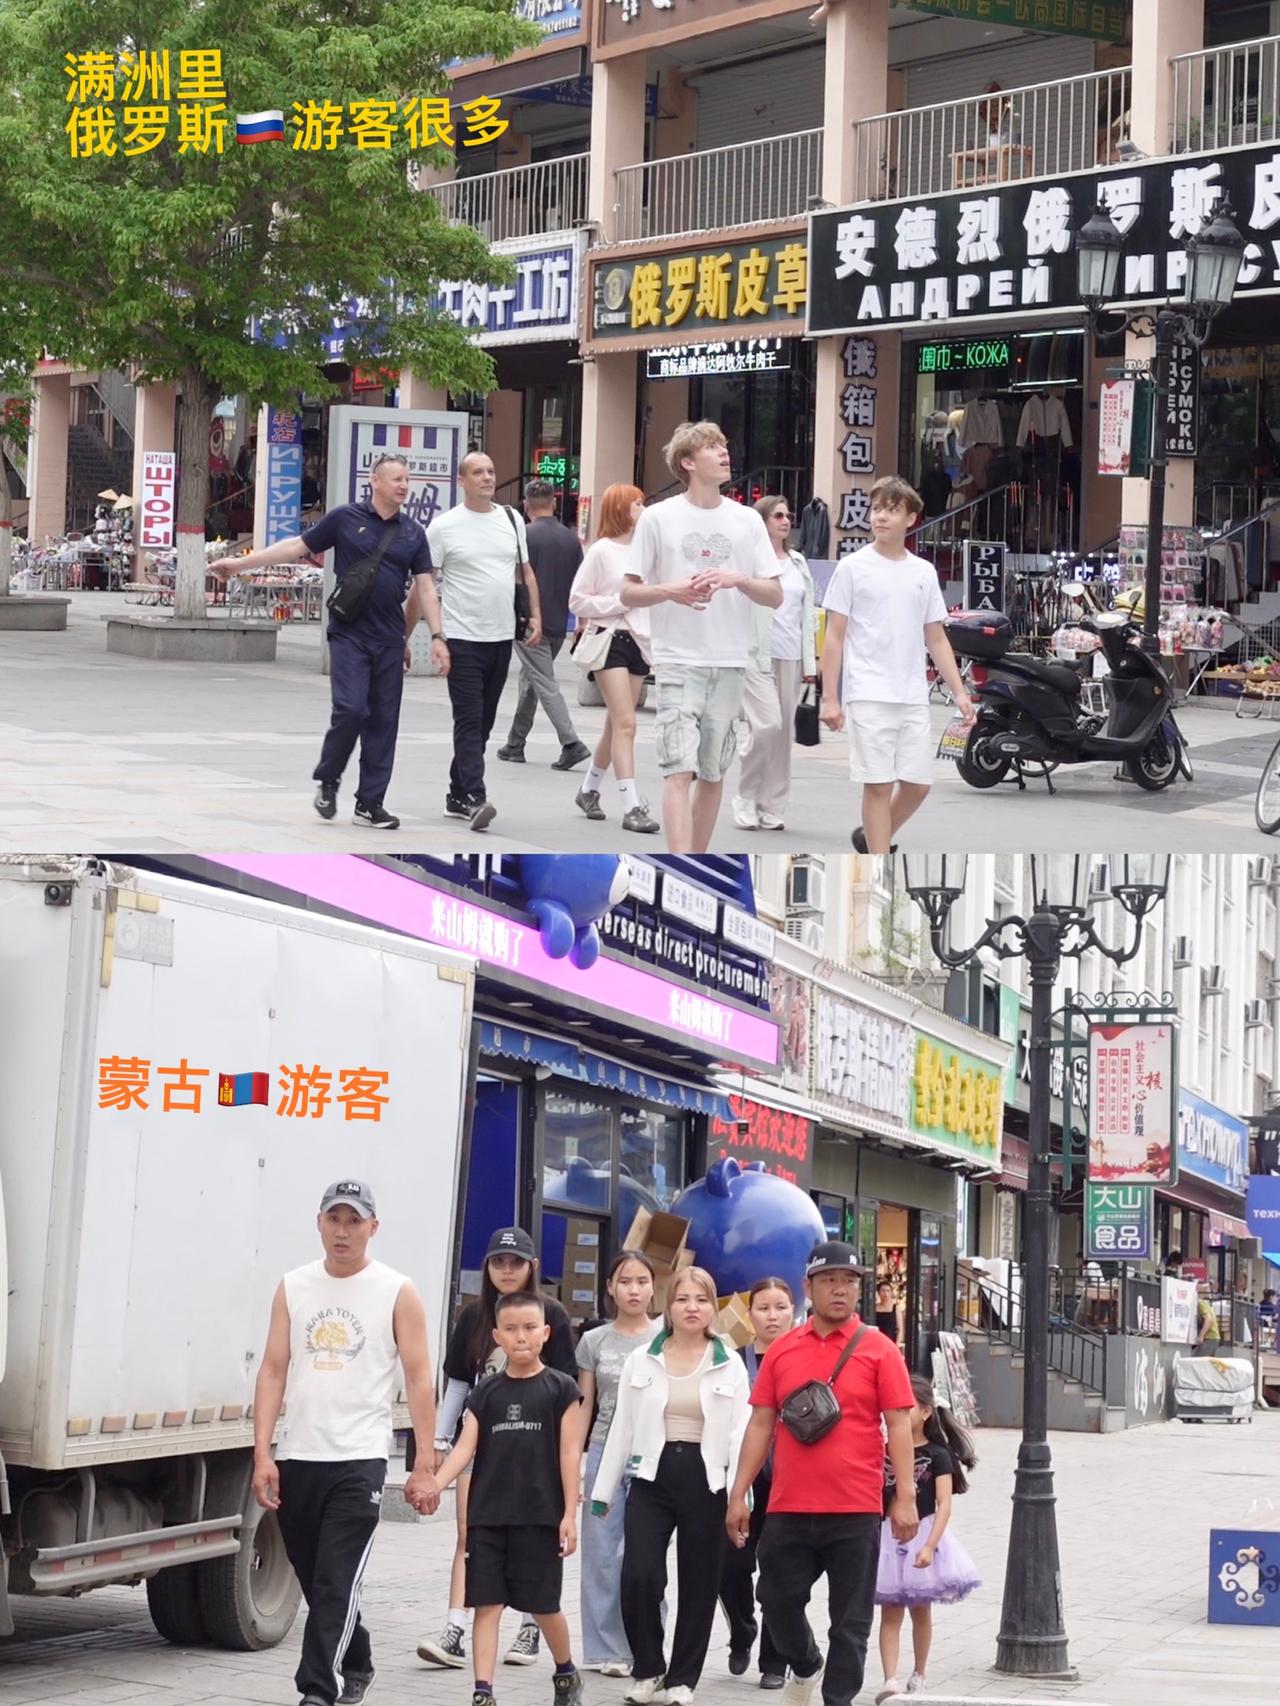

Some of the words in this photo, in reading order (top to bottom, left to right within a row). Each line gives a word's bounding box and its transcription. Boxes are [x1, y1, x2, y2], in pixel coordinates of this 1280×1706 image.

[629, 243, 807, 328] 俄罗斯皮草
[857, 258, 1049, 321] АНДРЕЙ
[965, 340, 1009, 367] КОЖА
[1178, 365, 1194, 437] СУМОК
[146, 453, 173, 465] НАТАША
[408, 461, 449, 473] 罗斯超市
[143, 467, 175, 545] ШТОРЫ
[268, 446, 300, 547] ИГРУШК
[972, 546, 1001, 612] РЫБА
[598, 911, 652, 950] verseas
[654, 926, 695, 967] direct
[1094, 1186, 1142, 1209] 大山
[1094, 1225, 1142, 1249] 食品
